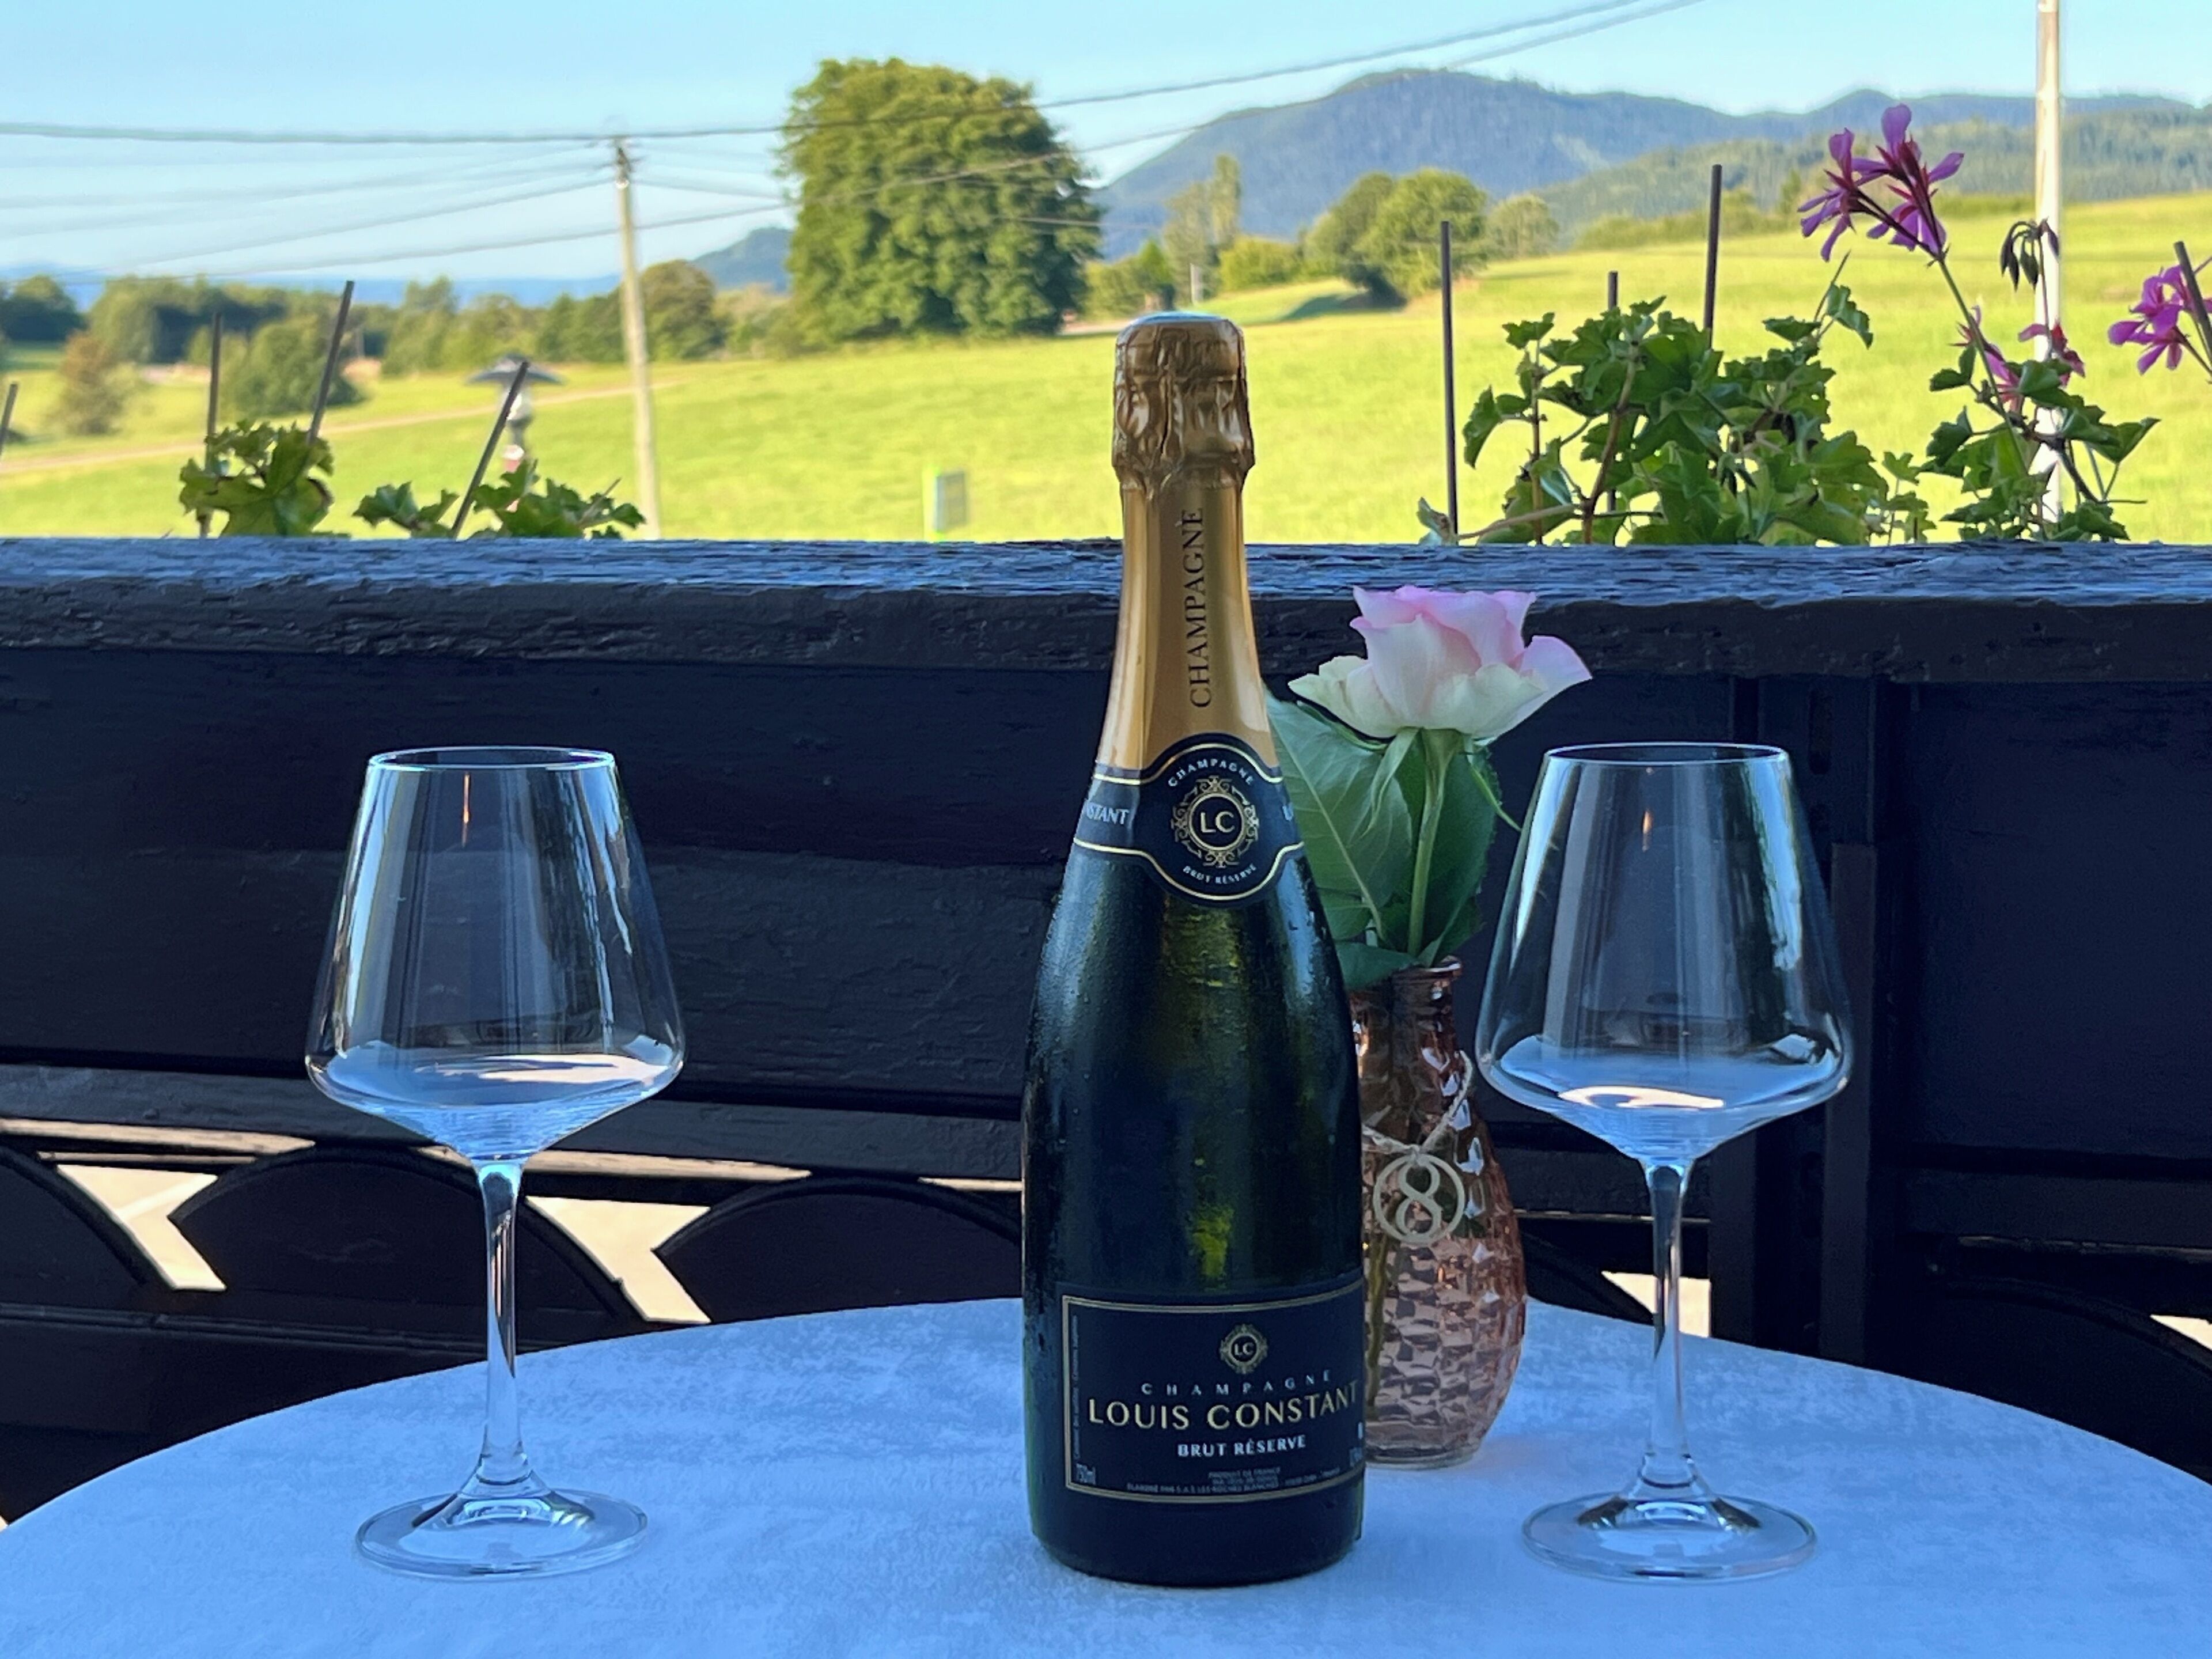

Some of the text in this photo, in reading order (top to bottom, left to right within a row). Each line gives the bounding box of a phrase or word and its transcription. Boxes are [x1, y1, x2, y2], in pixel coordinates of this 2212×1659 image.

[1181, 507, 1210, 708] CHAMPAGNE
[1168, 758, 1254, 787] CHAMPAGNE
[1200, 810, 1234, 834] LC
[1183, 866, 1211, 884] BRUT
[1234, 1343, 1253, 1356] LC
[1141, 1369, 1331, 1396] CHAMPAGNE
[1089, 1380, 1358, 1430] LOUIS CONSTANT
[1177, 1434, 1306, 1458] BRUT RÉSERVE
